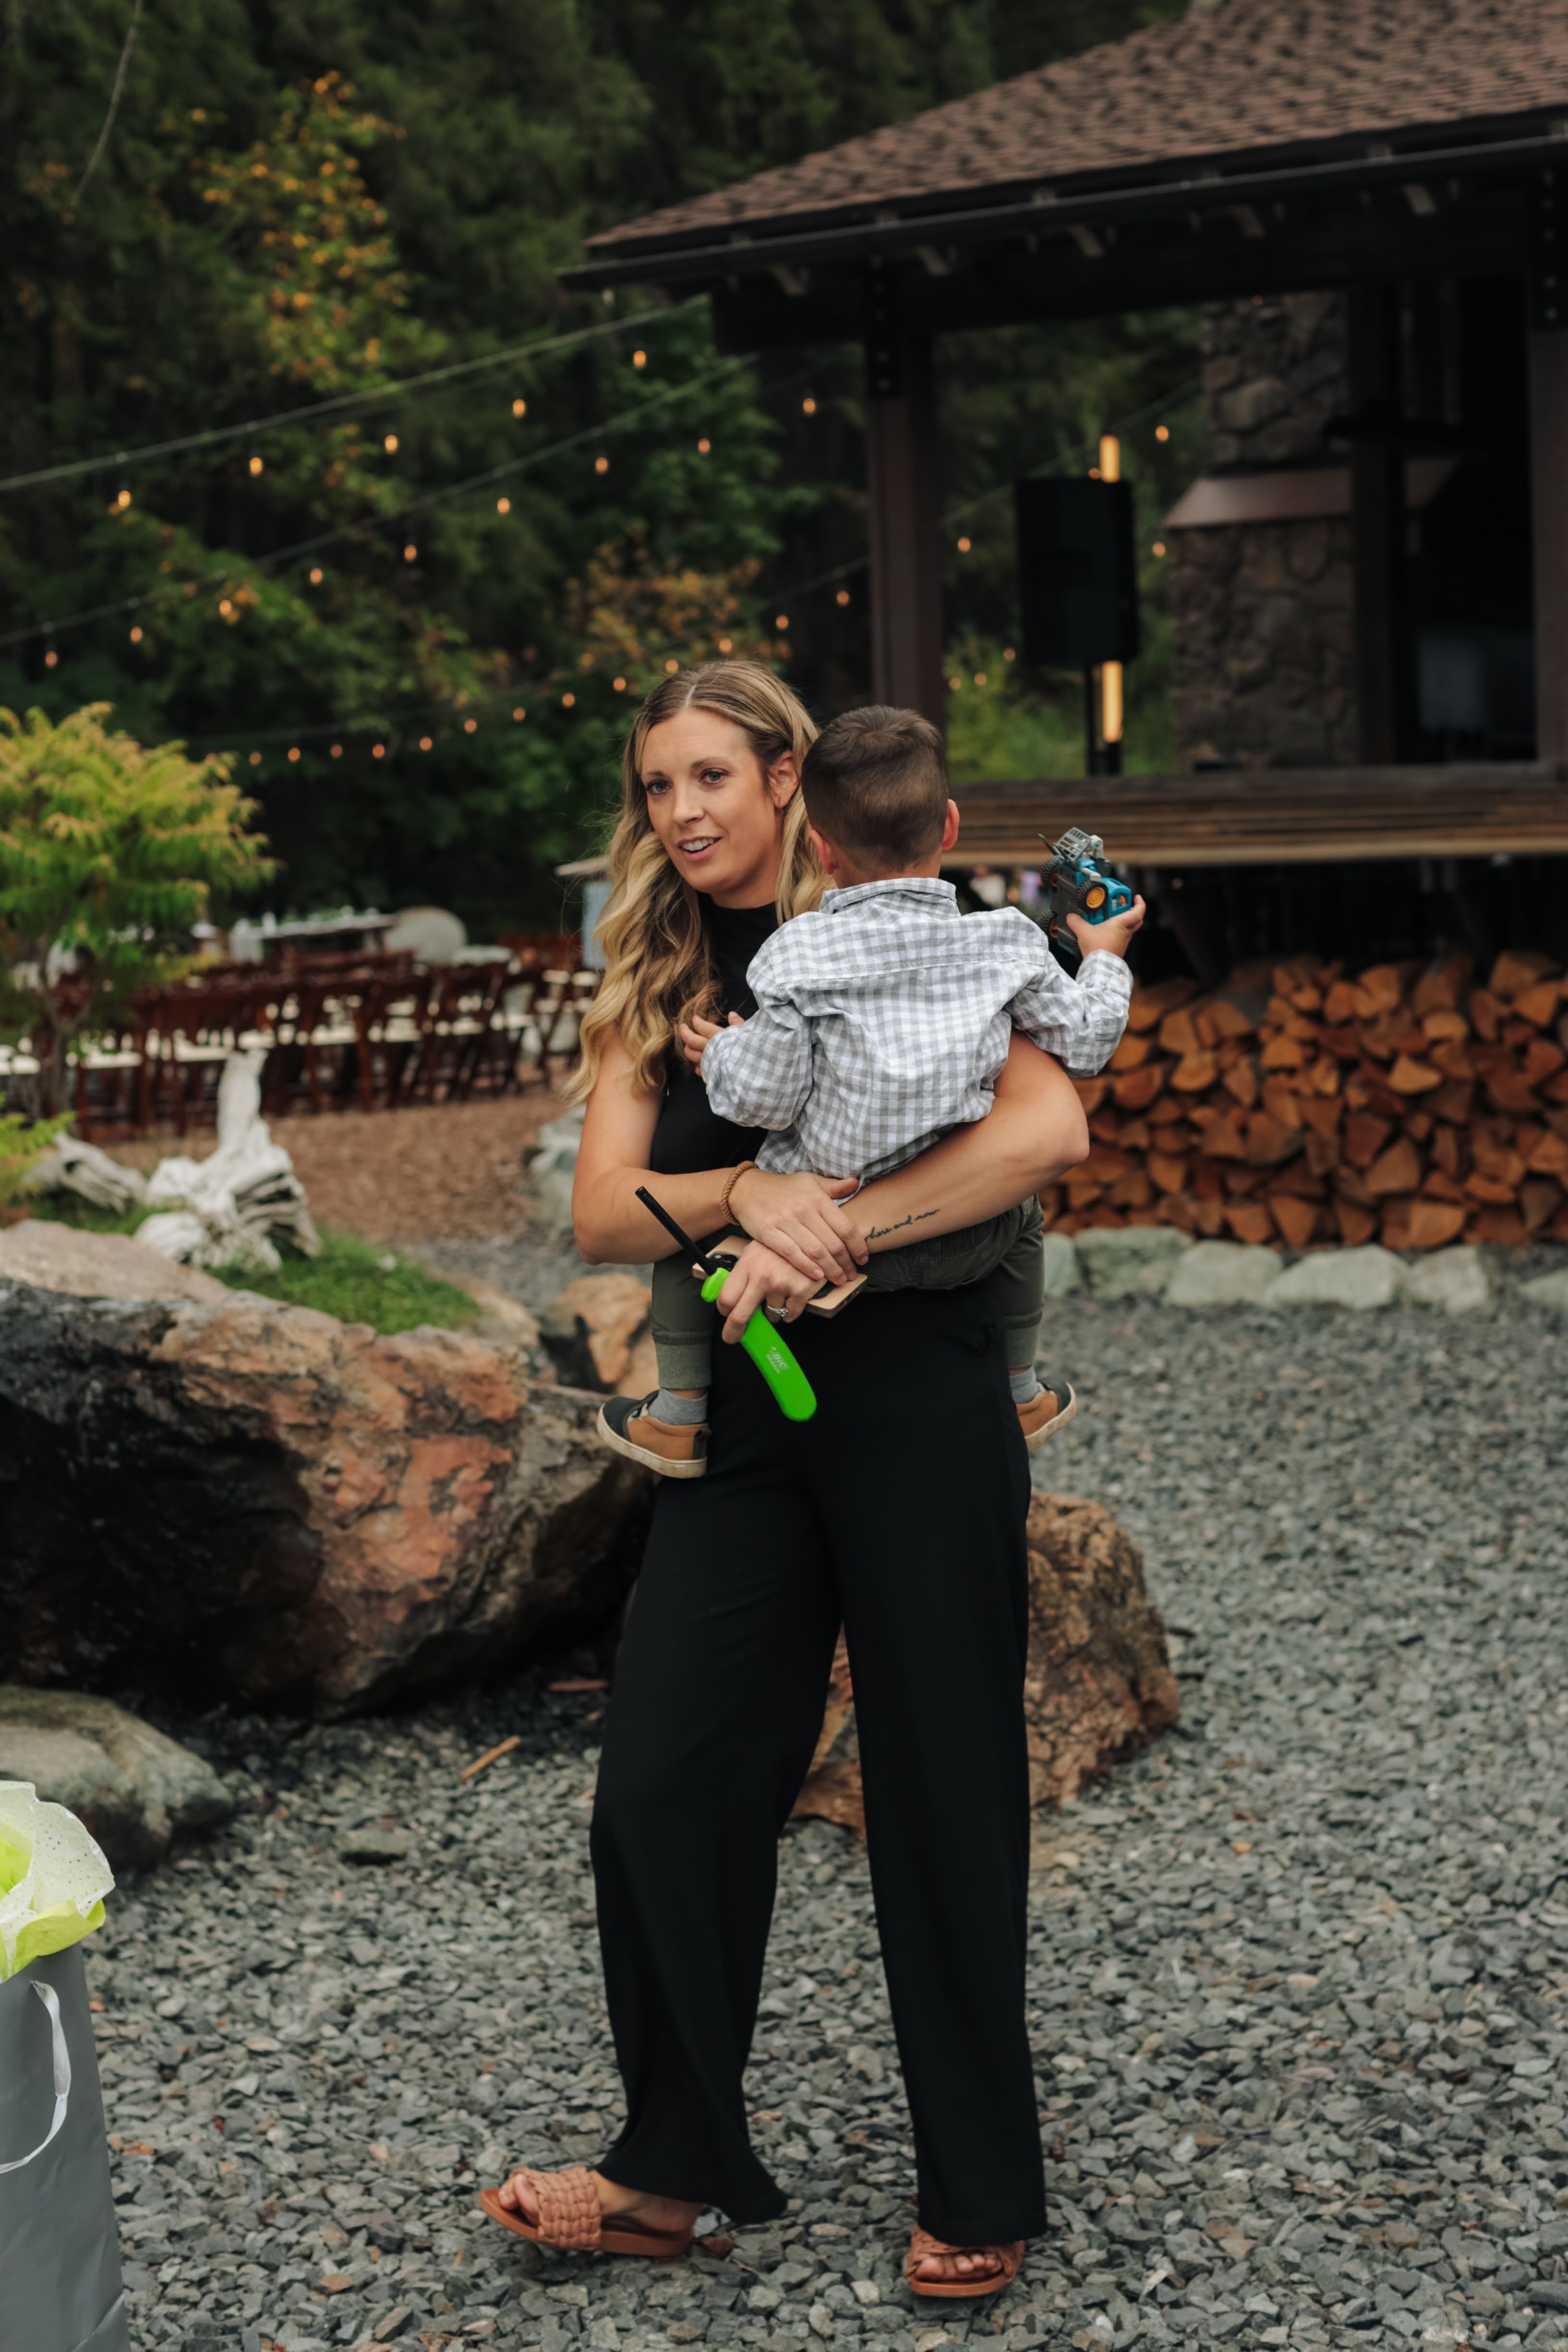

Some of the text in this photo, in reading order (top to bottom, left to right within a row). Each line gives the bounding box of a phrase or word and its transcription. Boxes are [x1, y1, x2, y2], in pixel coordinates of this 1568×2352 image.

[893, 1215, 913, 1229] and
[914, 1209, 941, 1221] now
[772, 1353, 788, 1368] BIC
